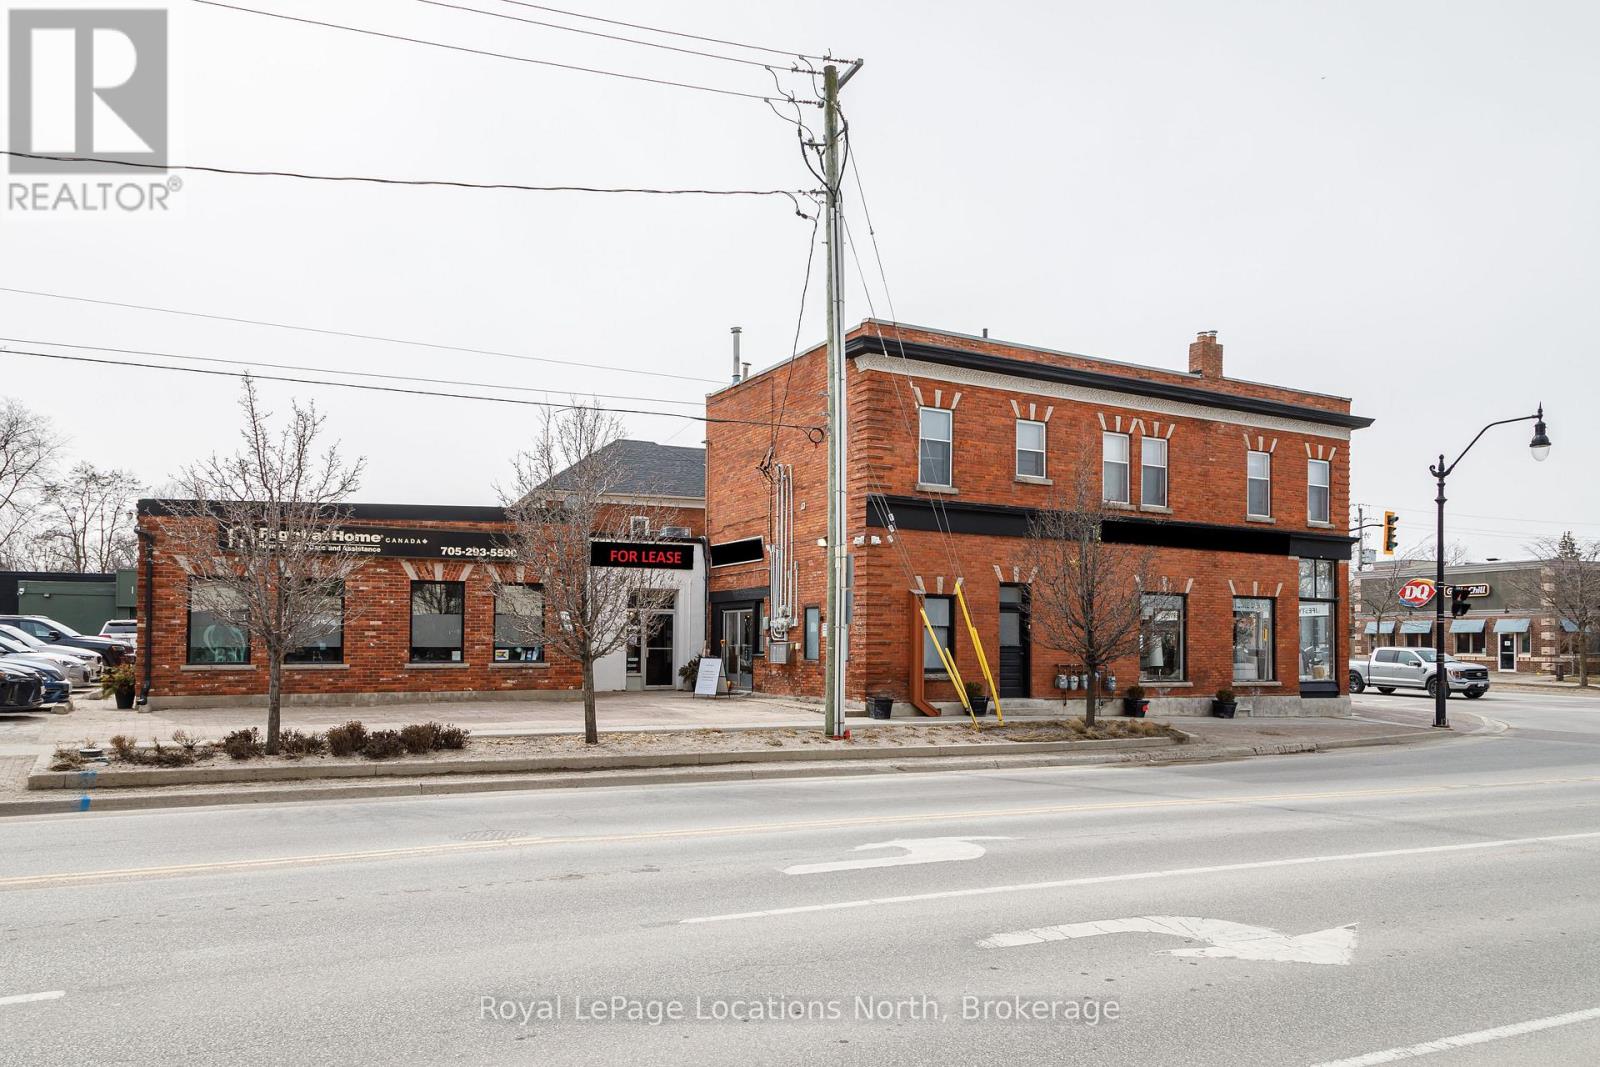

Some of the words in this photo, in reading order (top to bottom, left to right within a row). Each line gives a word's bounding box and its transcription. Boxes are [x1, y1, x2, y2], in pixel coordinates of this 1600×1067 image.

[332, 529, 381, 543] Home
[343, 545, 381, 553] Assistance
[610, 550, 638, 563] FOR
[641, 551, 682, 564] LEASE
[1404, 584, 1430, 601] DQ
